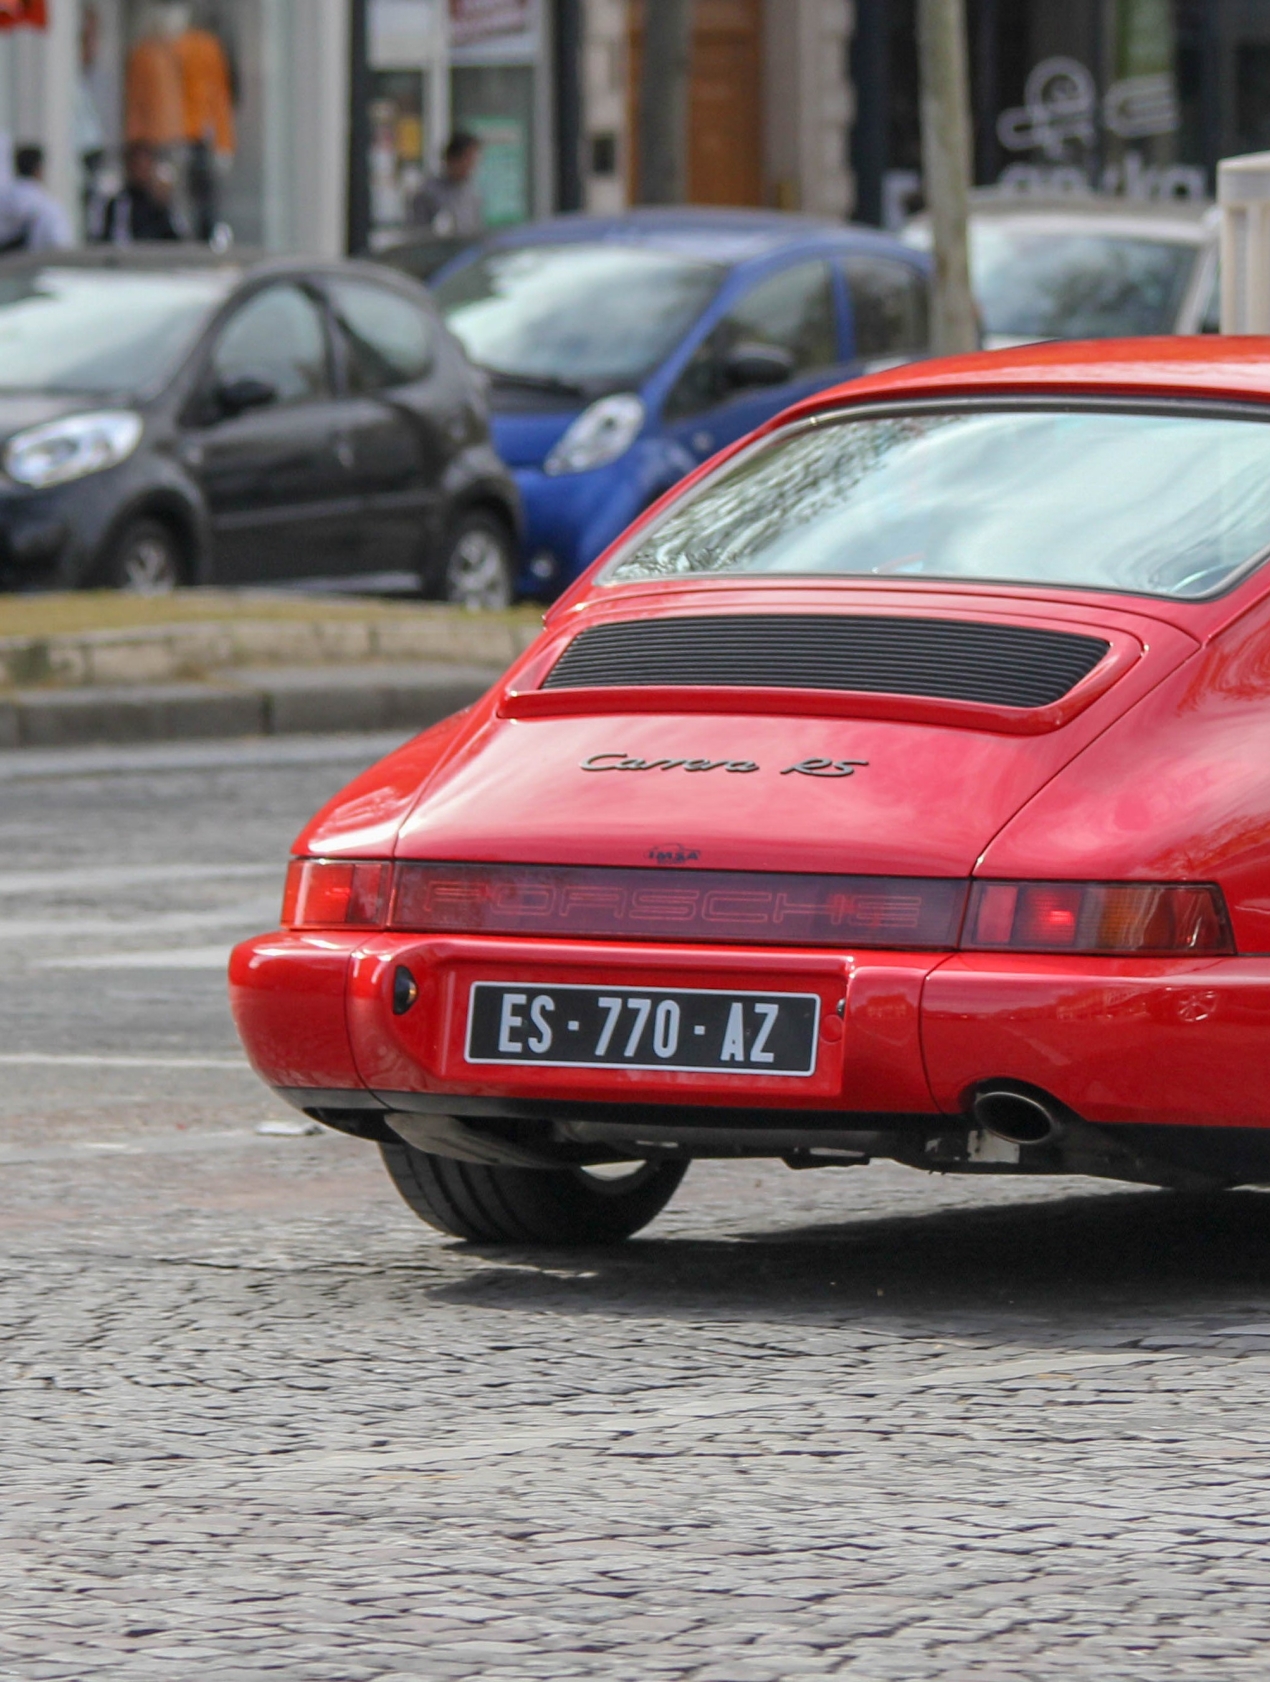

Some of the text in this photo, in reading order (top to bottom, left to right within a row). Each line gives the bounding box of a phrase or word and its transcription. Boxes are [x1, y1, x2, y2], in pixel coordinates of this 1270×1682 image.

[580, 752, 870, 778] Carrera RS
[425, 880, 922, 929] PORSCHE
